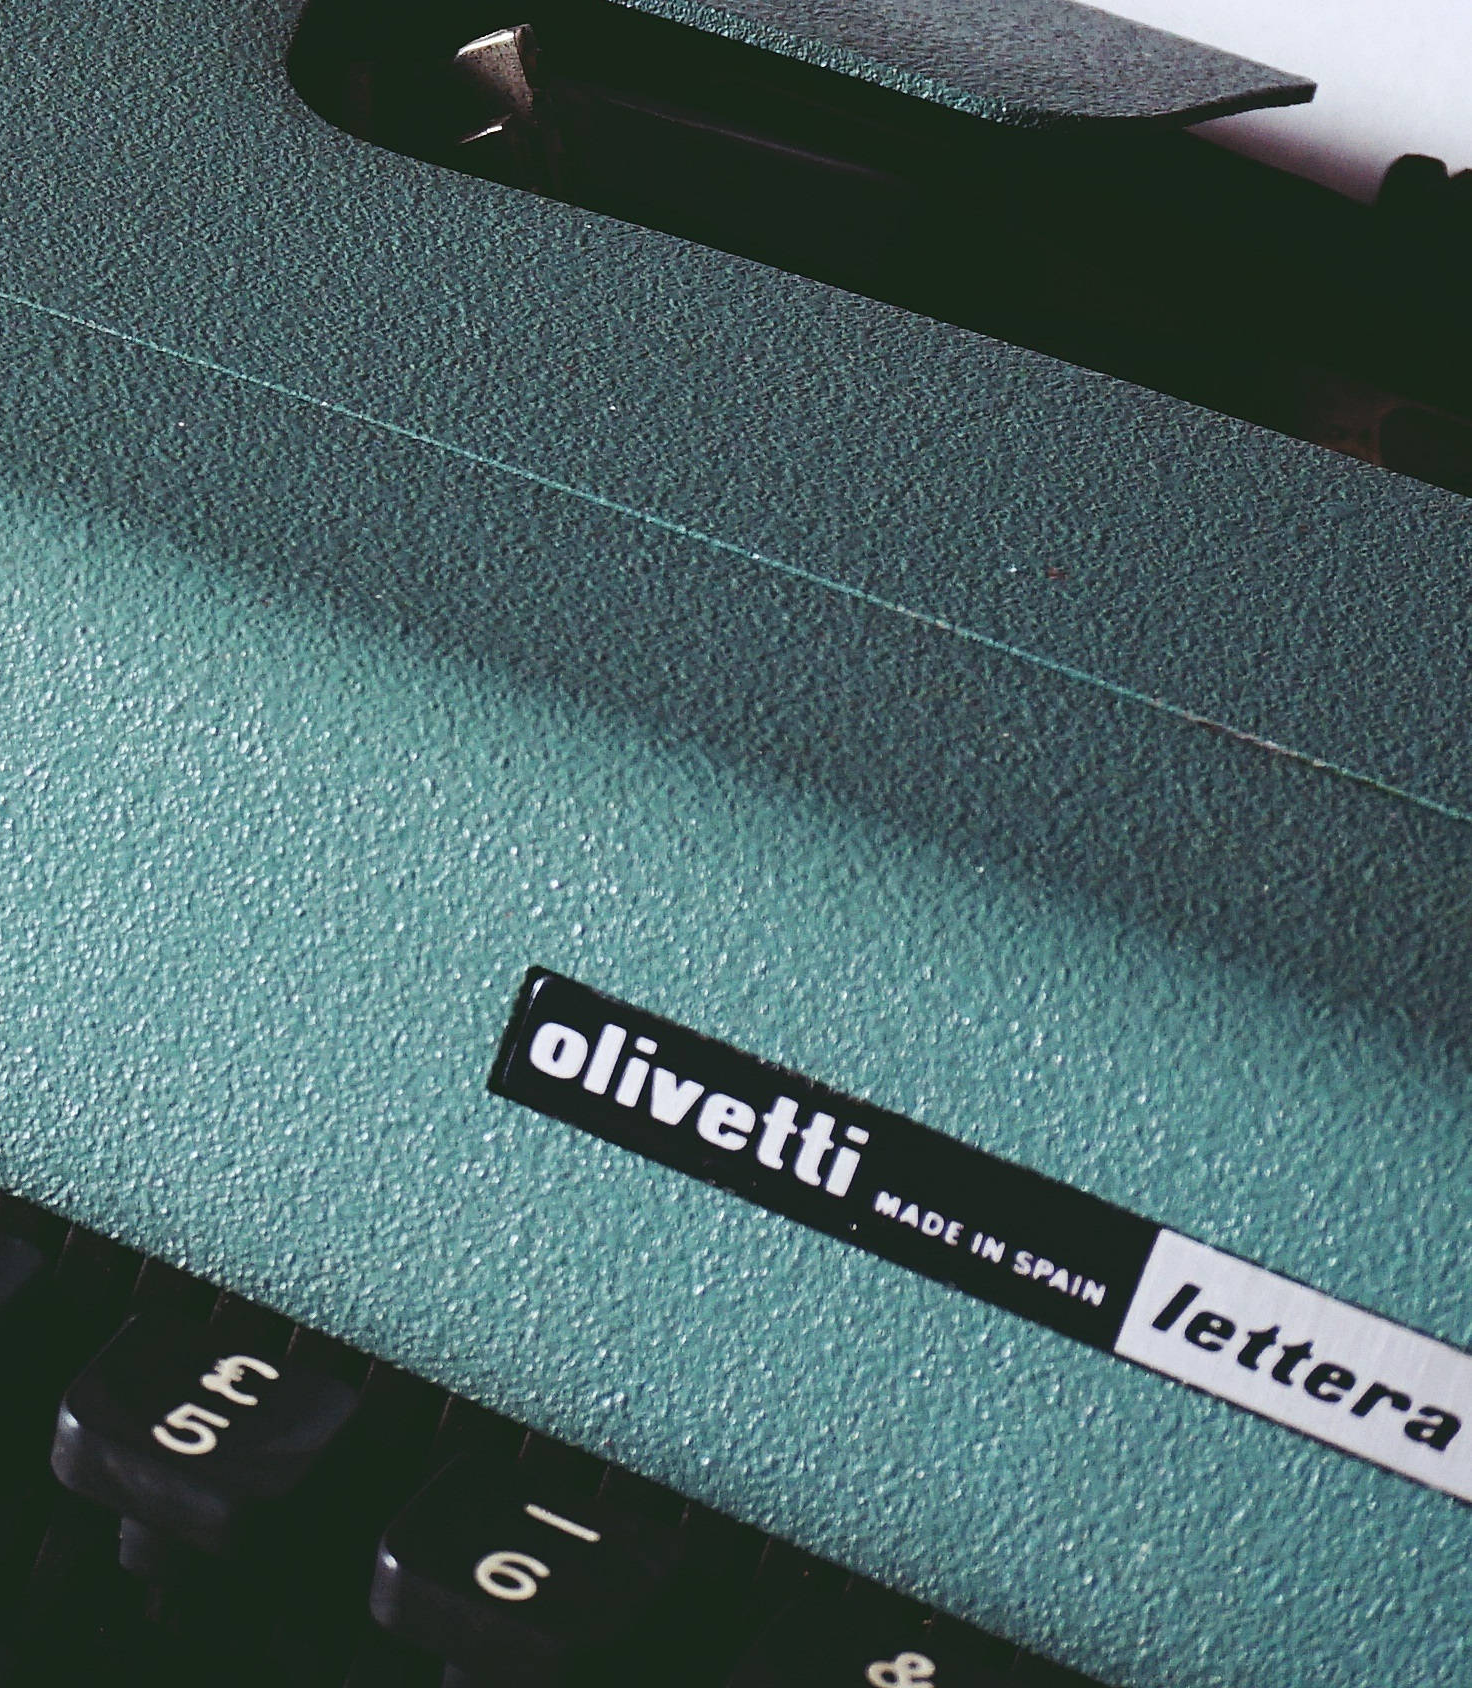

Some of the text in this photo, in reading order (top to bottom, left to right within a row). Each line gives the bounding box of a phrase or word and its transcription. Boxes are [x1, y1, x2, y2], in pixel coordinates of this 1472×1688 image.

[528, 1020, 1463, 1453] olivetti MADE IN SPAIN lettera
[152, 1402, 231, 1456] 5
[474, 1550, 551, 1601] 6
